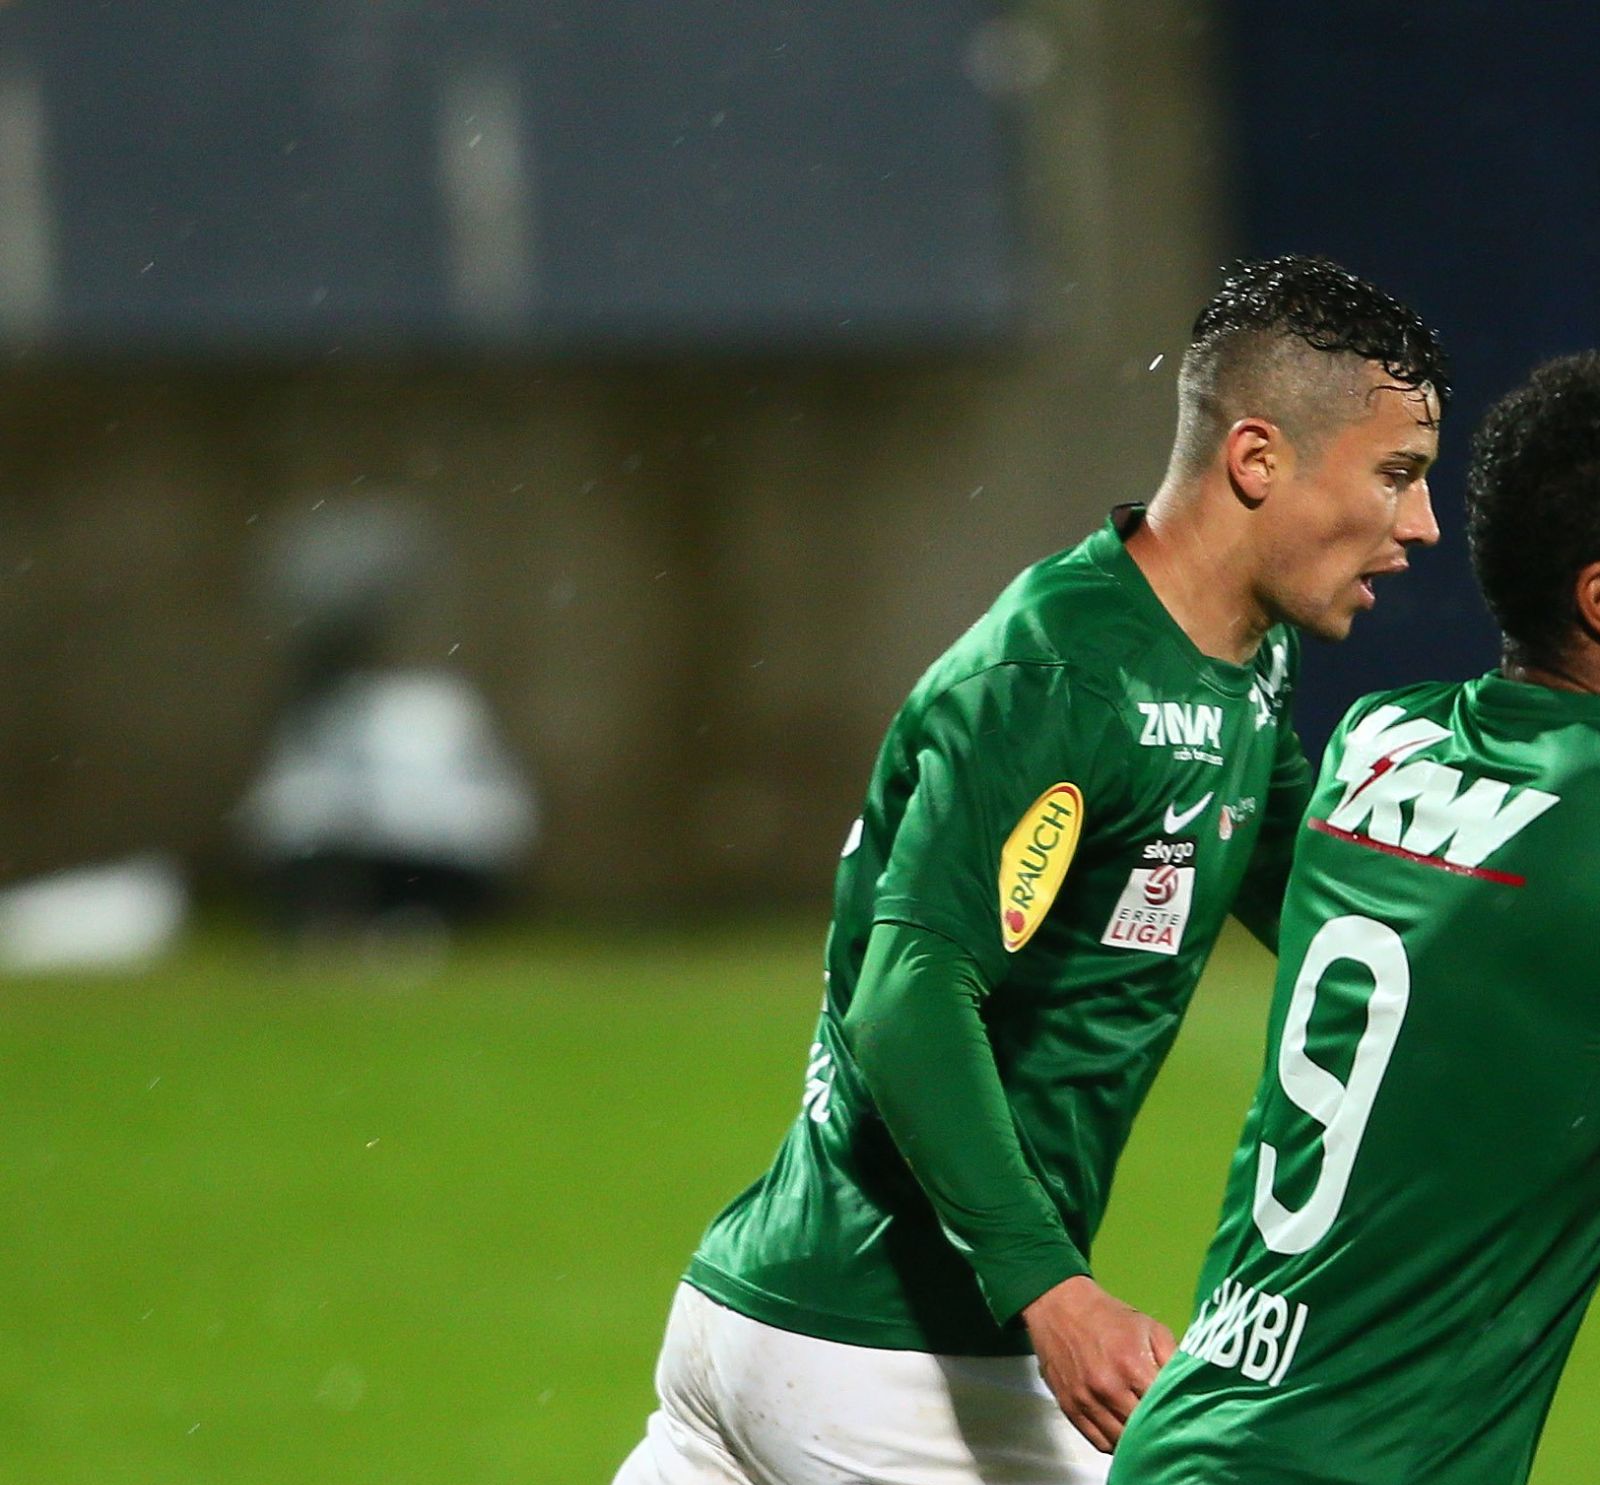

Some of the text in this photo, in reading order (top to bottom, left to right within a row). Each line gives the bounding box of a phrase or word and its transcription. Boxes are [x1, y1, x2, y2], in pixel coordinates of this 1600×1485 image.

[1009, 799, 1072, 910] RAUCH
[1111, 920, 1178, 947] LIGA
[1119, 908, 1182, 926] ERSTE
[1253, 914, 1410, 1255] 9
